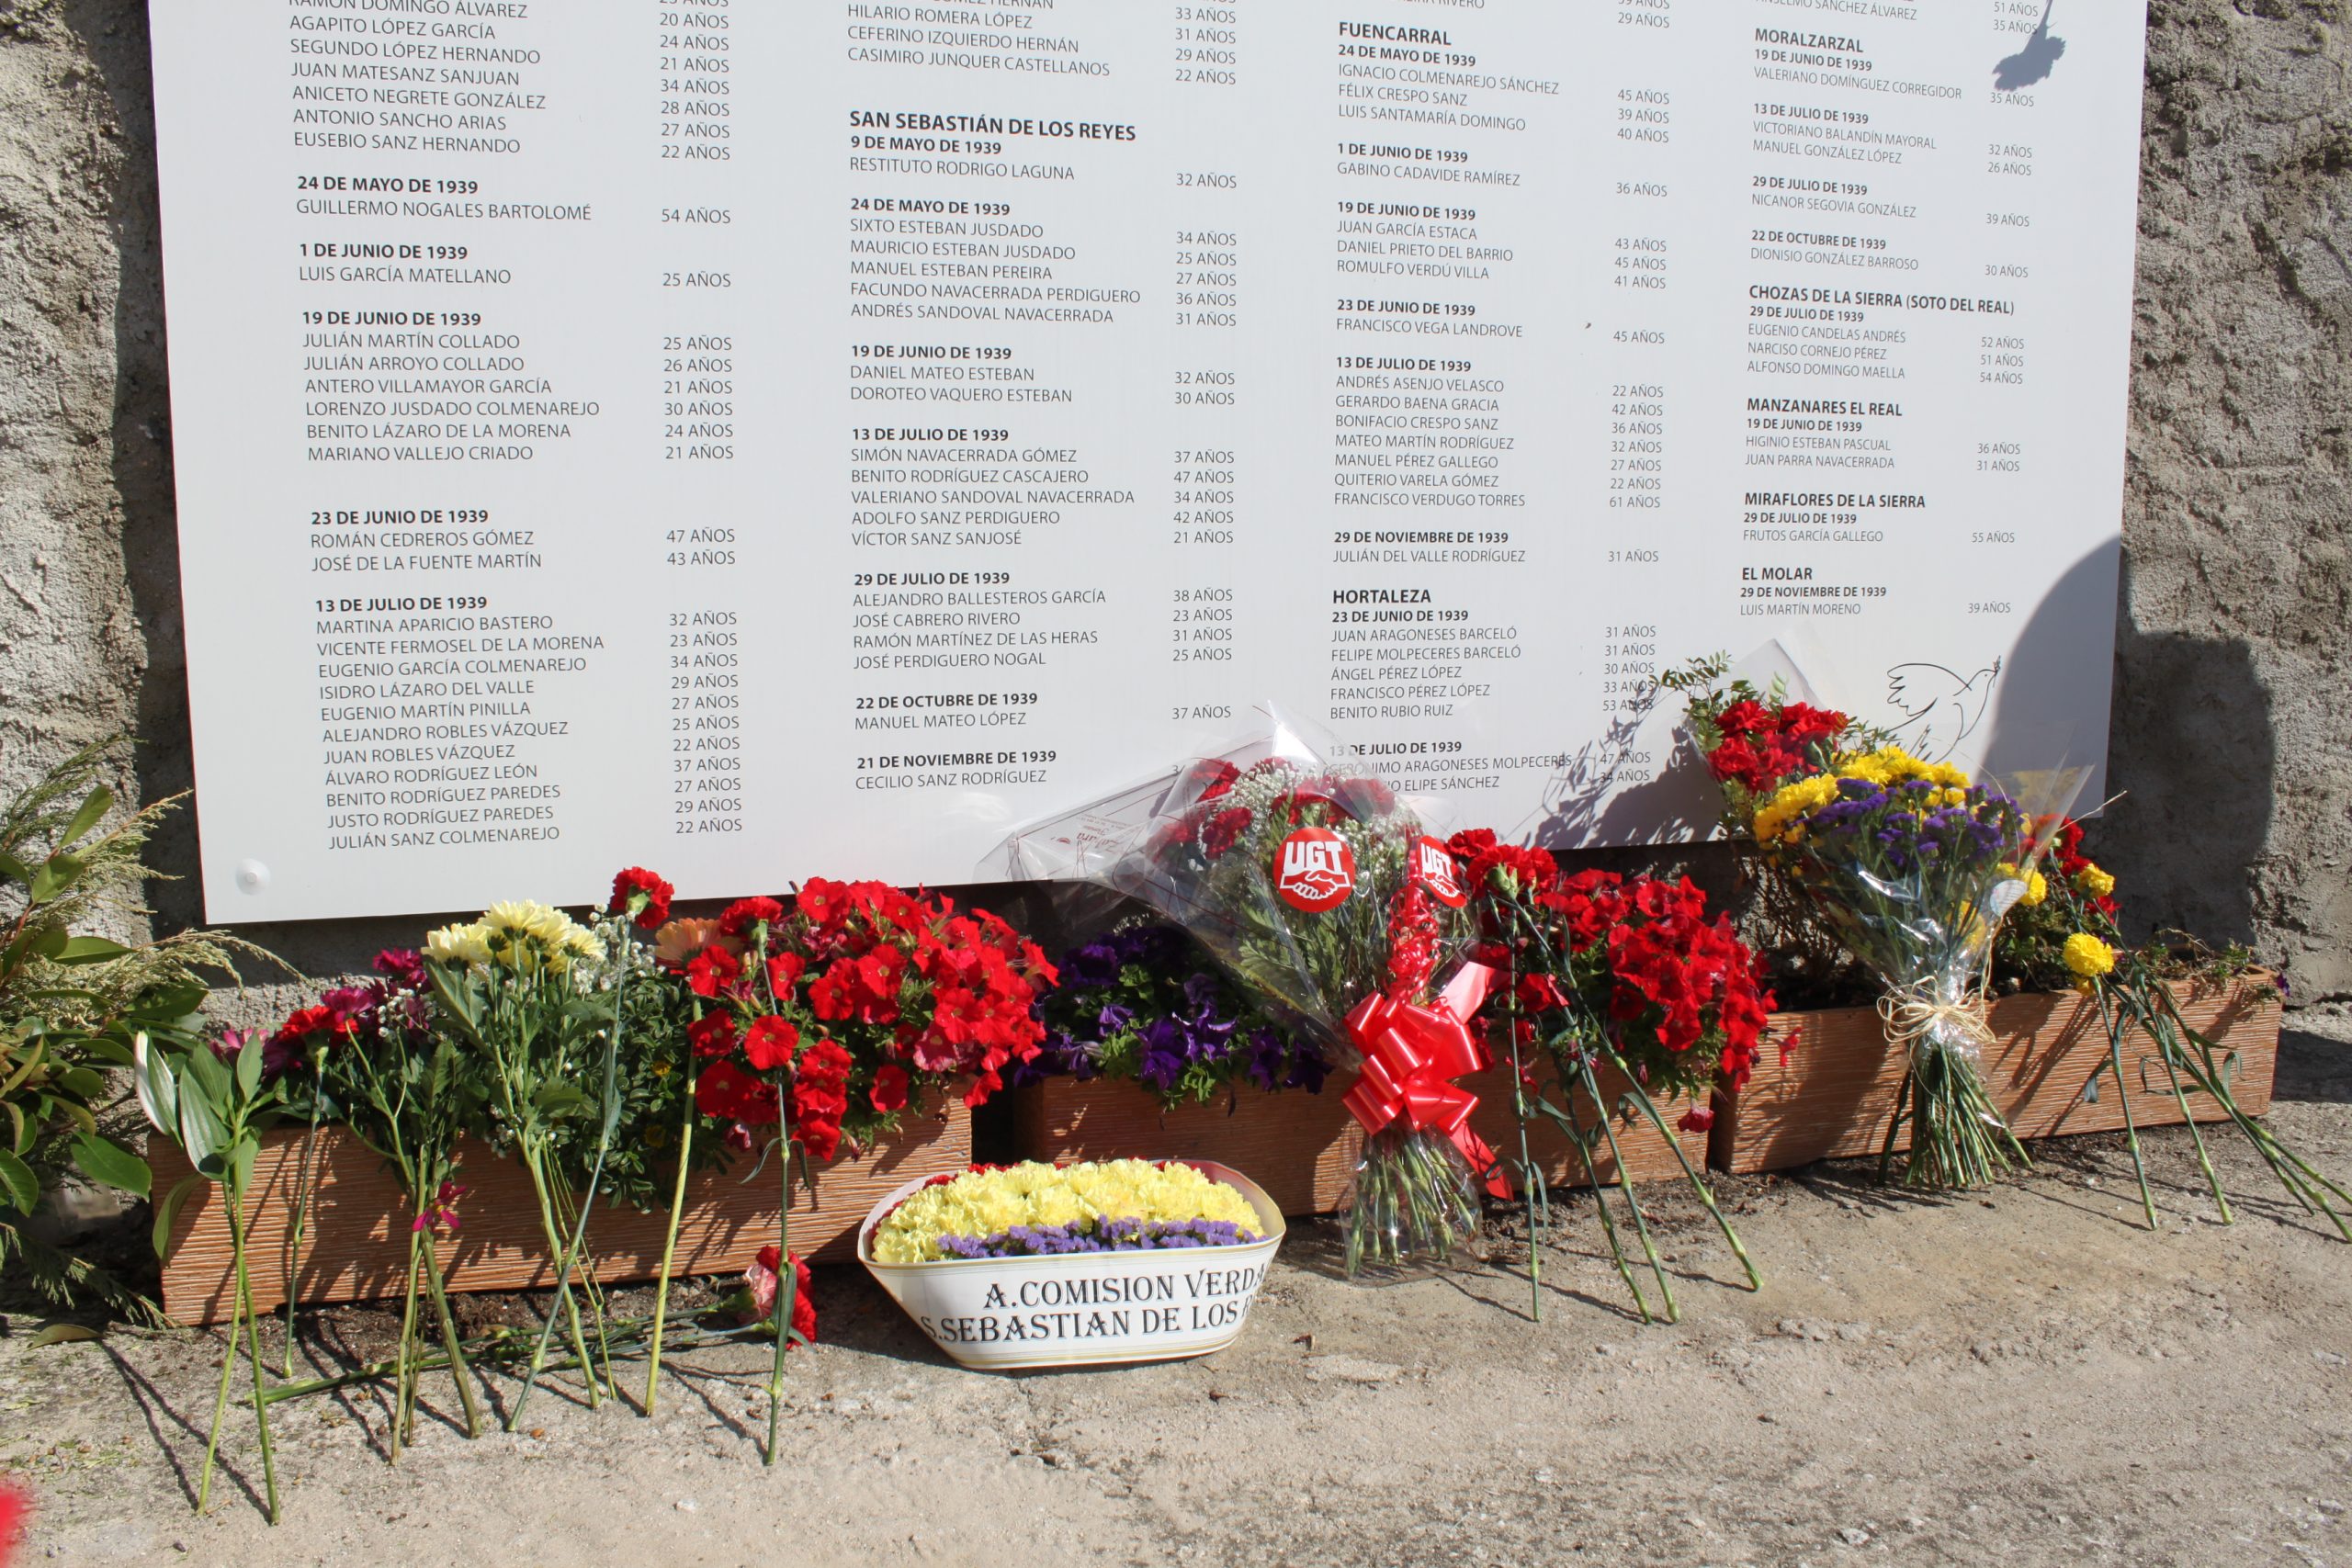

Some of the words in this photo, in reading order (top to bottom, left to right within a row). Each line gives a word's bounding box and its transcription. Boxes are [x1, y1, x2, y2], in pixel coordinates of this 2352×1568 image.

[289, 15, 368, 33] AGAPITO
[372, 17, 427, 37] LÓPEZ
[431, 22, 496, 39] GARCÍA
[1339, 21, 1452, 46] FUENCARRAL
[847, 25, 924, 43] CEFERINO
[928, 30, 1012, 49] IZQUIERDO
[1016, 36, 1079, 53] HERNÁN
[1755, 28, 1864, 53] MORALZARZAL
[847, 47, 924, 65] CASIMIRO
[928, 51, 1001, 70] JUNQUER
[1004, 56, 1110, 76] CASTELLANOS
[1175, 68, 1192, 82] 22
[1195, 68, 1237, 85] AÑOS
[1339, 63, 1396, 81] IGNACIO
[1398, 68, 1497, 89] COLMENAREJO
[1499, 76, 1559, 96] SÁNCHEZ
[1754, 66, 1818, 85] VALERIANO
[1820, 73, 1890, 92] DOMÍNGUEZ
[1892, 81, 1962, 99] CORREGIDOR
[292, 85, 368, 103] ANICETO
[373, 88, 449, 106] NEGRETE
[454, 91, 547, 109] GONZÁLEZ
[1617, 88, 1633, 102] 45
[1634, 88, 1670, 106] AÑOS
[849, 110, 890, 129] SAN
[895, 112, 1003, 134] SEBASTIÁN
[1008, 118, 1034, 136] DE
[1038, 119, 1074, 138] LOS
[1079, 122, 1136, 141] REYES
[1339, 104, 1367, 118] LUIS
[1370, 106, 1457, 126] SANTAMARÍA
[1460, 113, 1526, 131] DOMINGO
[1753, 120, 1823, 139] VICTORIANO
[1825, 127, 1883, 144] BALANDÍN
[1884, 133, 1937, 150] MAYORAL
[850, 156, 933, 175] RESTITUTO
[936, 160, 1008, 177] RODRIGO
[1012, 164, 1075, 180] LAGUNA
[1337, 162, 1391, 177] GABINO
[1393, 165, 1461, 182] CADAVIDE
[1464, 170, 1521, 186] RAMÍREZ
[297, 175, 320, 190] 24
[323, 175, 347, 191] DE
[352, 177, 404, 193] MAYO
[408, 178, 432, 193] DE
[436, 179, 479, 195] 1939
[1176, 172, 1193, 186] 32
[1196, 172, 1238, 189] AÑOS
[296, 198, 398, 216] GUILLERMO
[402, 201, 484, 219] NOGALES
[488, 203, 592, 220] BARTOLOMÉ
[661, 208, 681, 223] 54
[684, 207, 731, 224] AÑOS
[1752, 193, 1804, 209] NICANOR
[1807, 197, 1855, 213] SEGOVIA
[1857, 202, 1917, 219] GONZÁLEZ
[850, 239, 929, 255] MAURICIO
[933, 242, 1000, 258] ESTEBAN
[1002, 244, 1076, 260] JUSDADO
[851, 282, 928, 298] FACUNDO
[932, 284, 1043, 300] NAVACERRADA
[1046, 288, 1141, 303] PERDIGUERO
[1748, 284, 1809, 302] CHOZAS
[1812, 288, 1831, 303] DE
[1834, 289, 1851, 305] LA
[1855, 291, 1903, 308] SIERRA
[1905, 294, 1947, 310] (SOTO
[1950, 297, 1975, 312] DEL
[1977, 299, 2015, 317] REAL)
[1748, 322, 1799, 338] EUGENIO
[1801, 325, 1860, 341] CANDELAS
[1862, 330, 1906, 344] ANDRÉS
[306, 401, 387, 416] LORENZO
[390, 401, 472, 416] JUSDADO
[476, 401, 600, 416] COLMENAREJO
[664, 402, 684, 416] 30
[687, 400, 733, 416] AÑOS
[1747, 397, 1847, 415] MANZANARES
[1849, 401, 1866, 415] EL
[1869, 402, 1903, 417] REAL
[1335, 434, 1383, 447] MATEO
[1385, 434, 1436, 448] MARTÍN
[1440, 434, 1515, 450] RODRÍGUEZ
[851, 469, 907, 483] BENITO
[910, 467, 1000, 483] RODRÍGUEZ
[1002, 469, 1089, 483] CASCAJERO
[1334, 472, 1397, 487] QUITERIO
[1399, 474, 1449, 487] VARELA
[1451, 472, 1499, 488] GÓMEZ
[851, 491, 937, 504] VALERIANO
[941, 490, 1023, 504] SANDOVAL
[1027, 490, 1135, 503] NAVACERRADA
[1745, 491, 1834, 507] MIRAFLORES
[1837, 493, 1856, 507] DE
[1859, 494, 1876, 508] LA
[1879, 494, 1926, 508] SIERRA
[1333, 531, 1351, 544] 29
[1353, 531, 1372, 544] DE
[1374, 531, 1454, 544] NOVIEMBRE
[1456, 531, 1475, 544] DE
[1477, 532, 1509, 544] 1939
[1742, 567, 1758, 581] EL
[1761, 567, 1813, 581] MOLAR
[853, 592, 944, 607] ALEJANDRO
[947, 591, 1048, 605] BALLESTEROS
[1051, 590, 1106, 604] GARCÍA
[1173, 589, 1190, 603] 38
[1193, 587, 1233, 602] AÑOS
[1332, 589, 1431, 604] HORTALEZA
[1740, 587, 1755, 598] 29
[1757, 586, 1772, 598] DE
[1774, 586, 1841, 598] NOVIEMBRE
[1843, 586, 1858, 597] DE
[1860, 586, 1887, 597] 1939
[1740, 604, 1764, 616] LUIS
[1766, 604, 1810, 615] MARTÍN
[1812, 603, 1861, 615] MORENO
[1967, 603, 1981, 615] 39
[1982, 600, 2011, 614] AÑOS
[316, 619, 394, 635] MARTINA
[399, 616, 475, 633] APARICIO
[480, 615, 553, 631] BASTERO
[1331, 629, 1366, 643] JUAN
[1369, 628, 1456, 641] ARAGONESES
[1459, 626, 1517, 640] BARCELÓ
[1331, 649, 1374, 662] FELIPE
[1376, 647, 1461, 661] MOLPECERES
[1464, 644, 1521, 660] BARCELÓ
[1604, 645, 1618, 657] 31
[1621, 642, 1656, 657] AÑOS
[1330, 685, 1405, 701] FRANCISCO
[1408, 684, 1447, 698] PÉREZ
[1450, 682, 1491, 697] LÓPEZ
[855, 774, 913, 790] CECILIO
[917, 773, 957, 787] SANZ
[961, 769, 1046, 785] RODRÍGUEZ
[675, 820, 695, 834] 22
[697, 817, 742, 833] AÑOS
[328, 831, 387, 851] JULIÁN
[390, 831, 435, 847] SANZ
[439, 826, 560, 845] COLMENAREJO
[1283, 840, 1343, 874] UGT
[1420, 842, 1453, 878] UGT
[1141, 1306, 1182, 1334] DE
[1192, 1300, 1238, 1330] LOS
